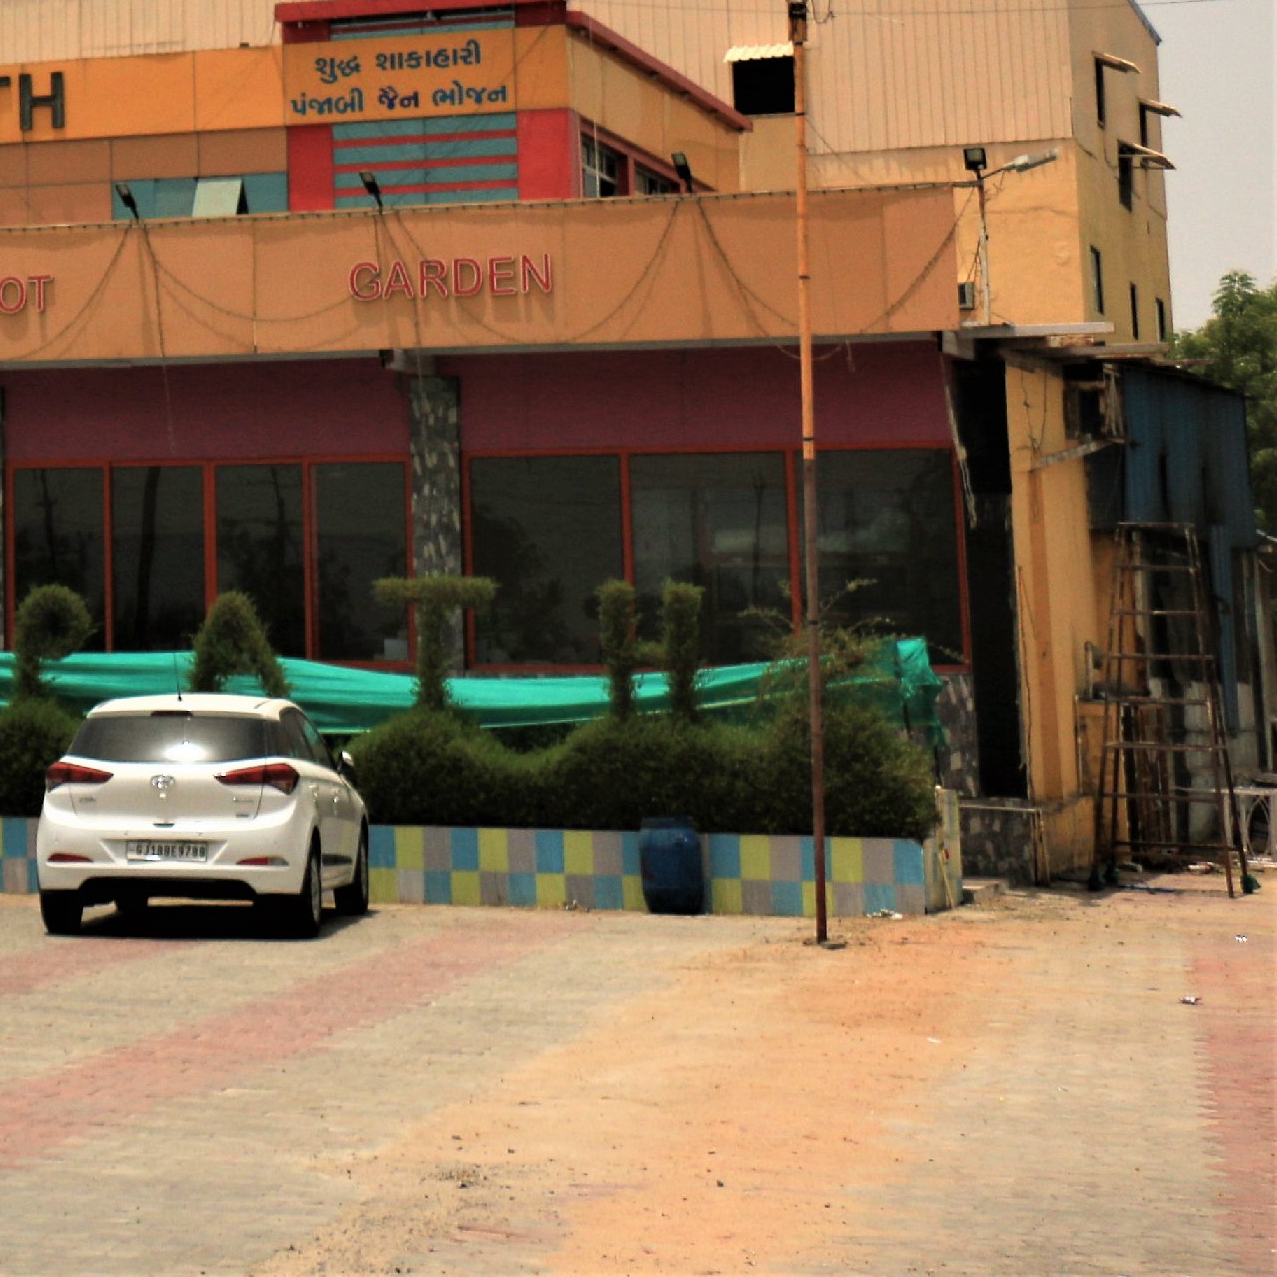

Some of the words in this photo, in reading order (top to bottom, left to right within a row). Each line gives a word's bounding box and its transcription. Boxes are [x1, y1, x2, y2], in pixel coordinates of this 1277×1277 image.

[315, 56, 361, 84] શુદ્ધ
[375, 38, 482, 71] શાકાહારી
[291, 87, 364, 115] પંજાબી
[378, 85, 420, 111] જૈન
[432, 80, 508, 107] ભોજન
[348, 252, 555, 301] GARDEN
